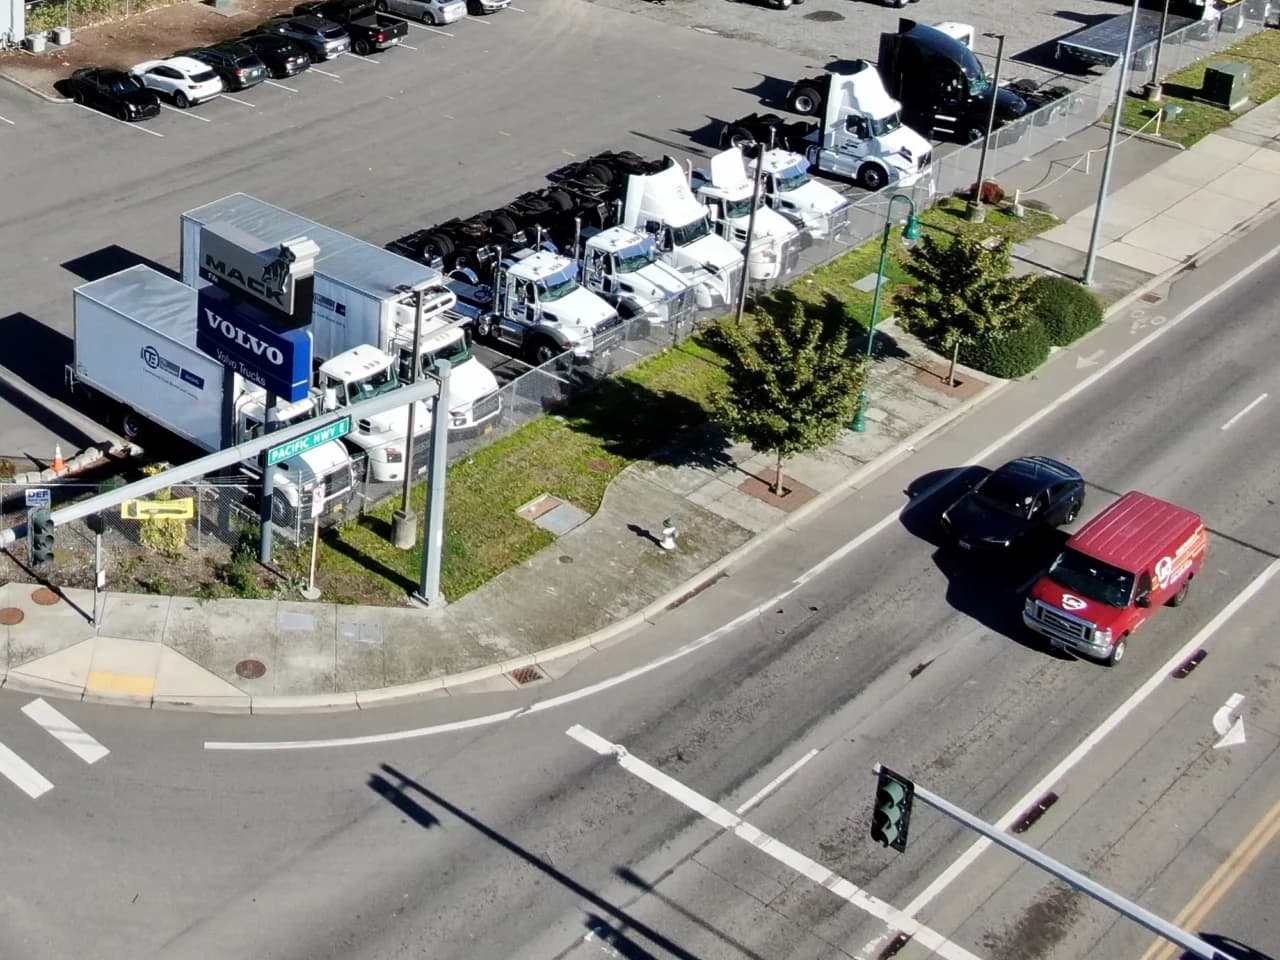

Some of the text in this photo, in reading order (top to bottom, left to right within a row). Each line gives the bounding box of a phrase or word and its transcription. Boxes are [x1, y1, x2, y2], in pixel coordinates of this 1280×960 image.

[206, 254, 284, 305] MACK
[204, 307, 284, 365] VOLVO
[216, 348, 266, 386] Volvo Trucks
[271, 422, 345, 462] PACIFIC HWY E
